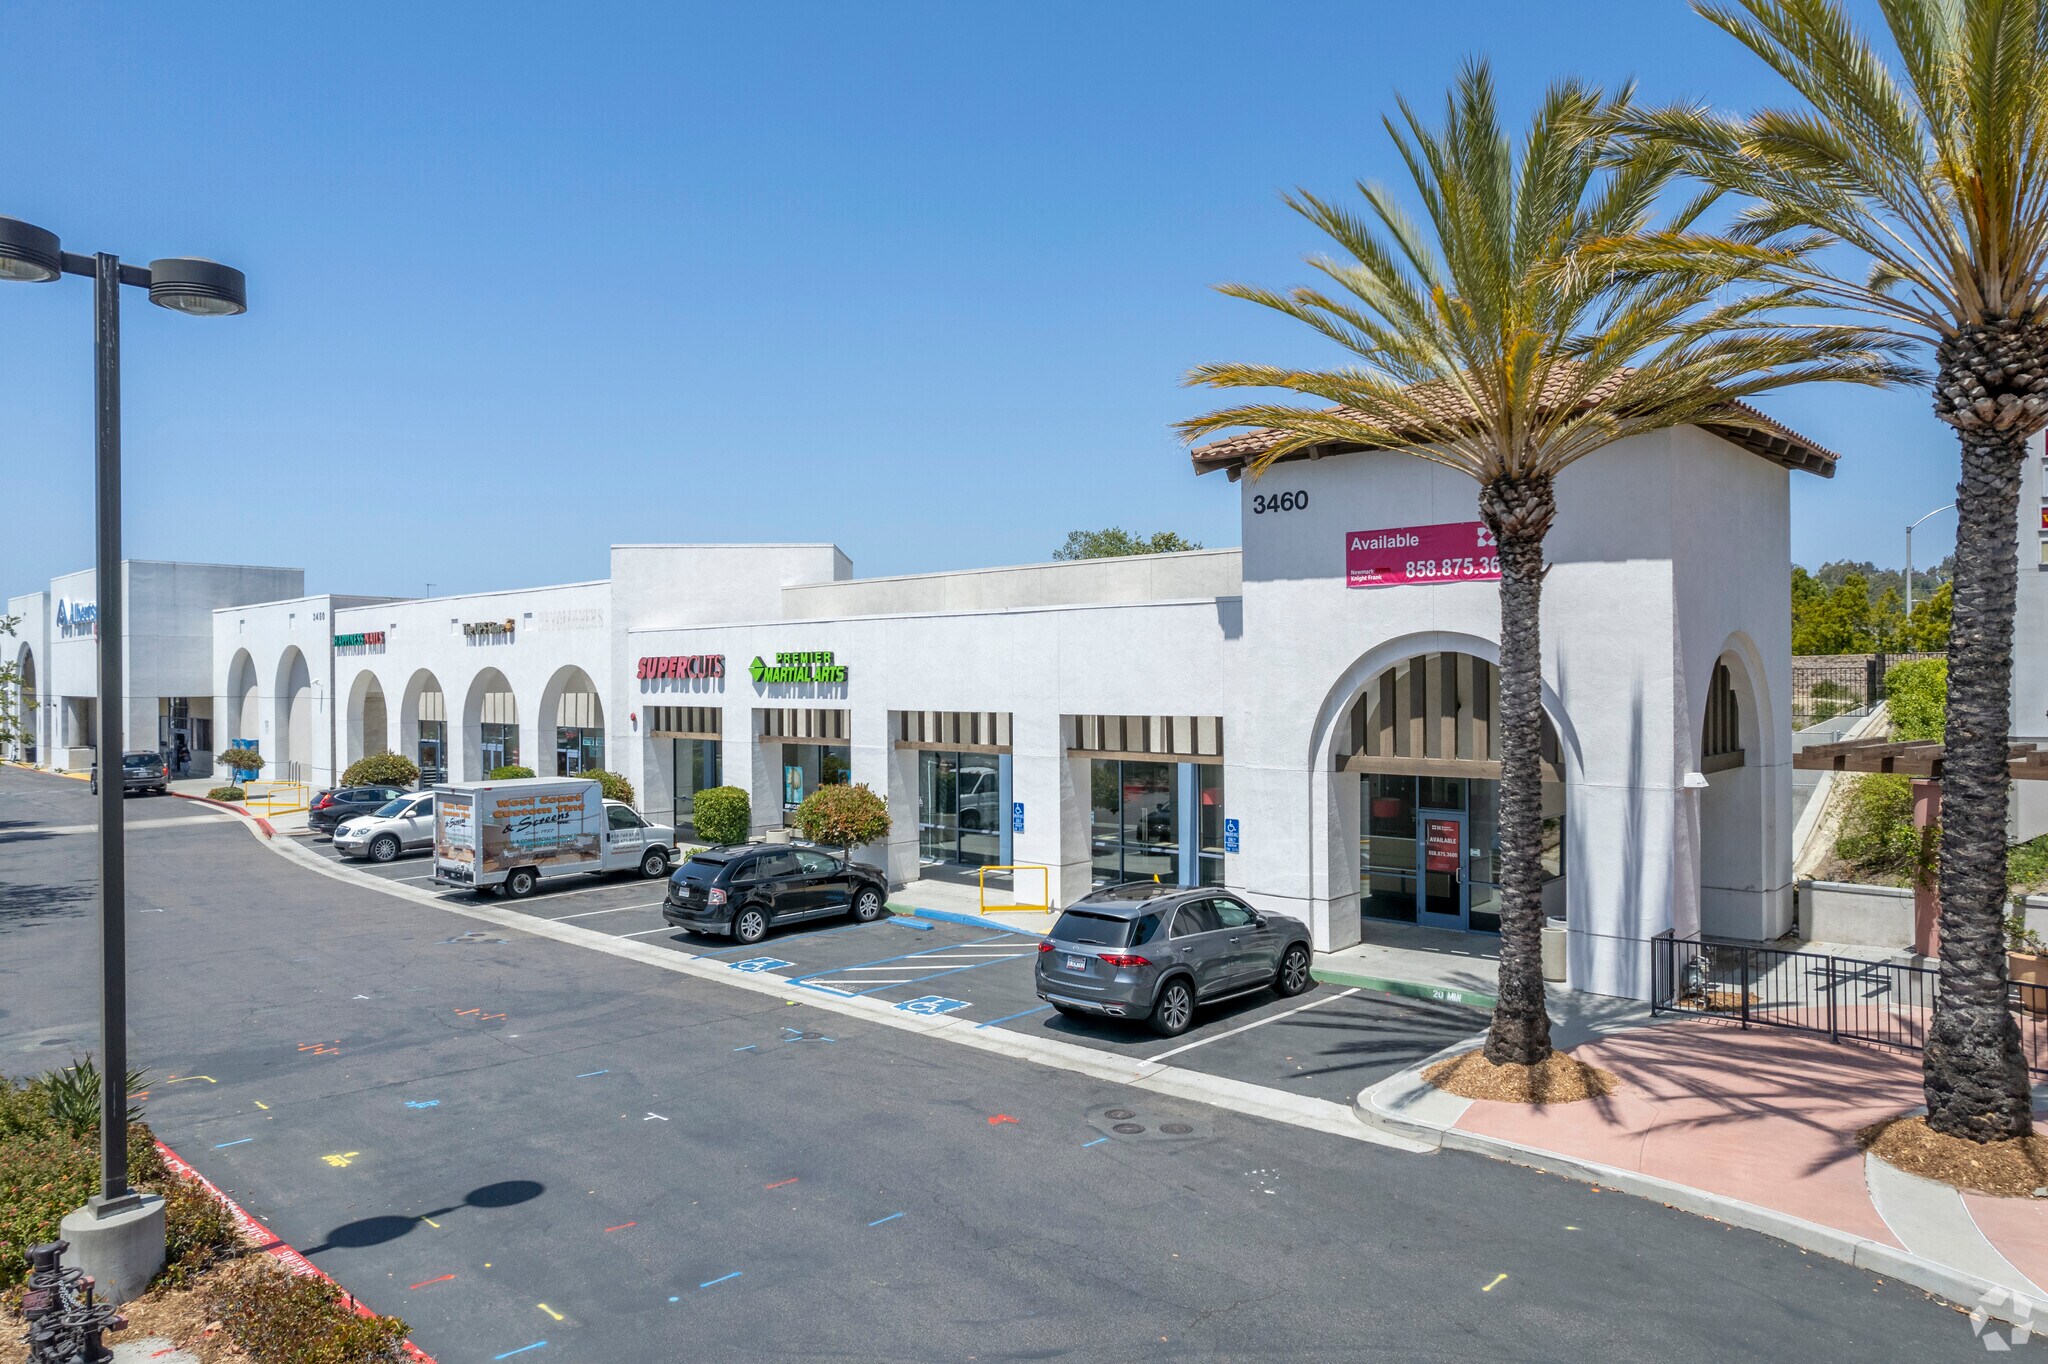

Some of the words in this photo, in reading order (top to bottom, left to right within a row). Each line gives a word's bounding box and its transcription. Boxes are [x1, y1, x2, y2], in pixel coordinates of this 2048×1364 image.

[1253, 490, 1309, 515] 3460
[1350, 533, 1420, 551] Available
[1350, 568, 1375, 576] Newmark
[1405, 556, 1500, 579] 858.875.36
[1350, 575, 1368, 583] Knight
[70, 602, 97, 624] Alberts
[462, 623, 476, 635] The
[475, 622, 489, 634] UPS
[488, 621, 505, 634] Store
[333, 633, 365, 647] HAPPINESS
[364, 631, 384, 645] NAILS
[776, 652, 832, 664] PREMIER
[636, 654, 724, 679] SUPERCUTS
[763, 666, 812, 683] MARTIAL
[813, 666, 846, 682] ARTS
[496, 797, 536, 808] West
[540, 794, 583, 805] Coast
[493, 807, 552, 819] Custom
[556, 803, 586, 813] Tint
[502, 824, 514, 834] &
[516, 812, 570, 833] Screens
[1429, 836, 1457, 845] AVAILABLE
[1432, 989, 1444, 999] 20
[1446, 991, 1463, 1002] MIN
